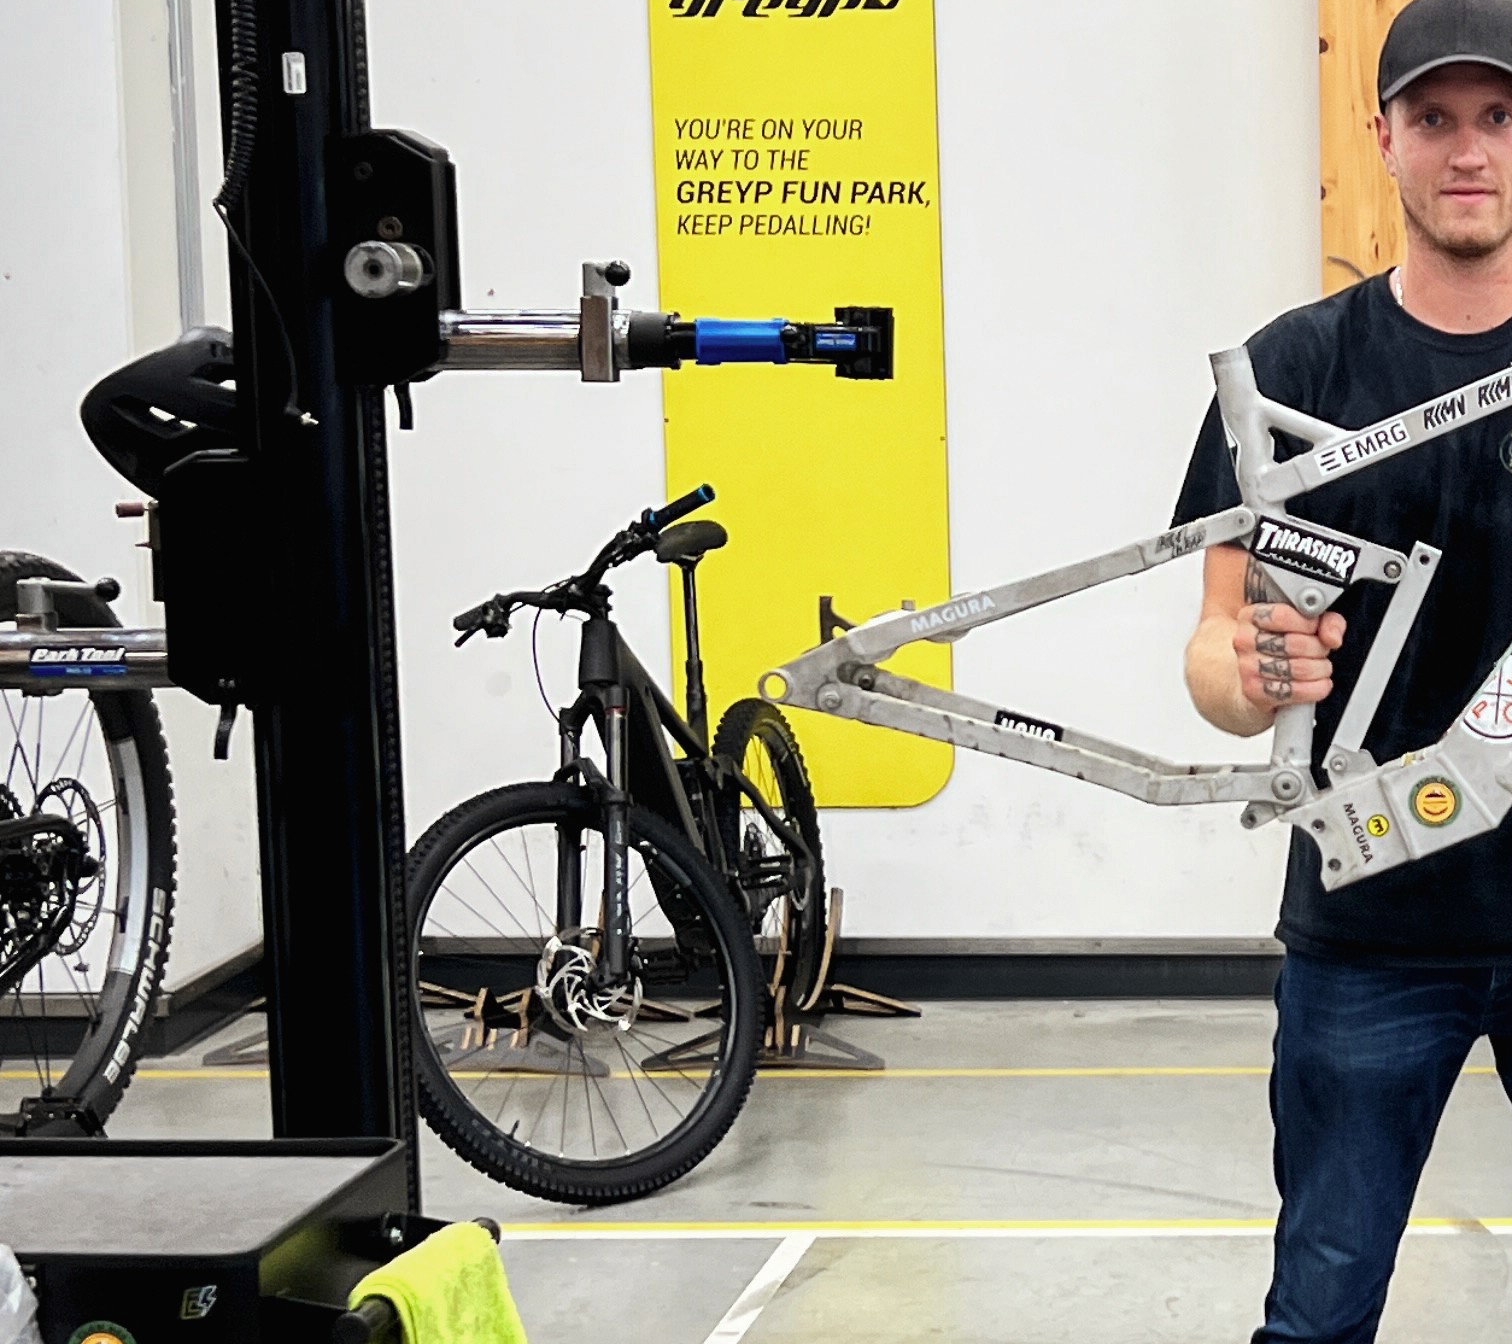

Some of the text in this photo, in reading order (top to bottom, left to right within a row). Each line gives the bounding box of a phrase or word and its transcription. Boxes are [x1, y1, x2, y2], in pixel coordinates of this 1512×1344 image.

[674, 118, 863, 140] YOU'RE ON YOUR
[675, 149, 810, 171] WAY TO THE
[676, 180, 931, 207] GREYP FUN PARK,
[676, 214, 871, 236] KEEP PEDALLING!
[1341, 423, 1407, 464] EMRG
[1255, 521, 1355, 579] THRASHER
[910, 595, 996, 633] MAGURA
[31, 647, 126, 663] Park Tool
[1343, 802, 1374, 864] MAGURA
[94, 887, 166, 1085] SCHWALBE
